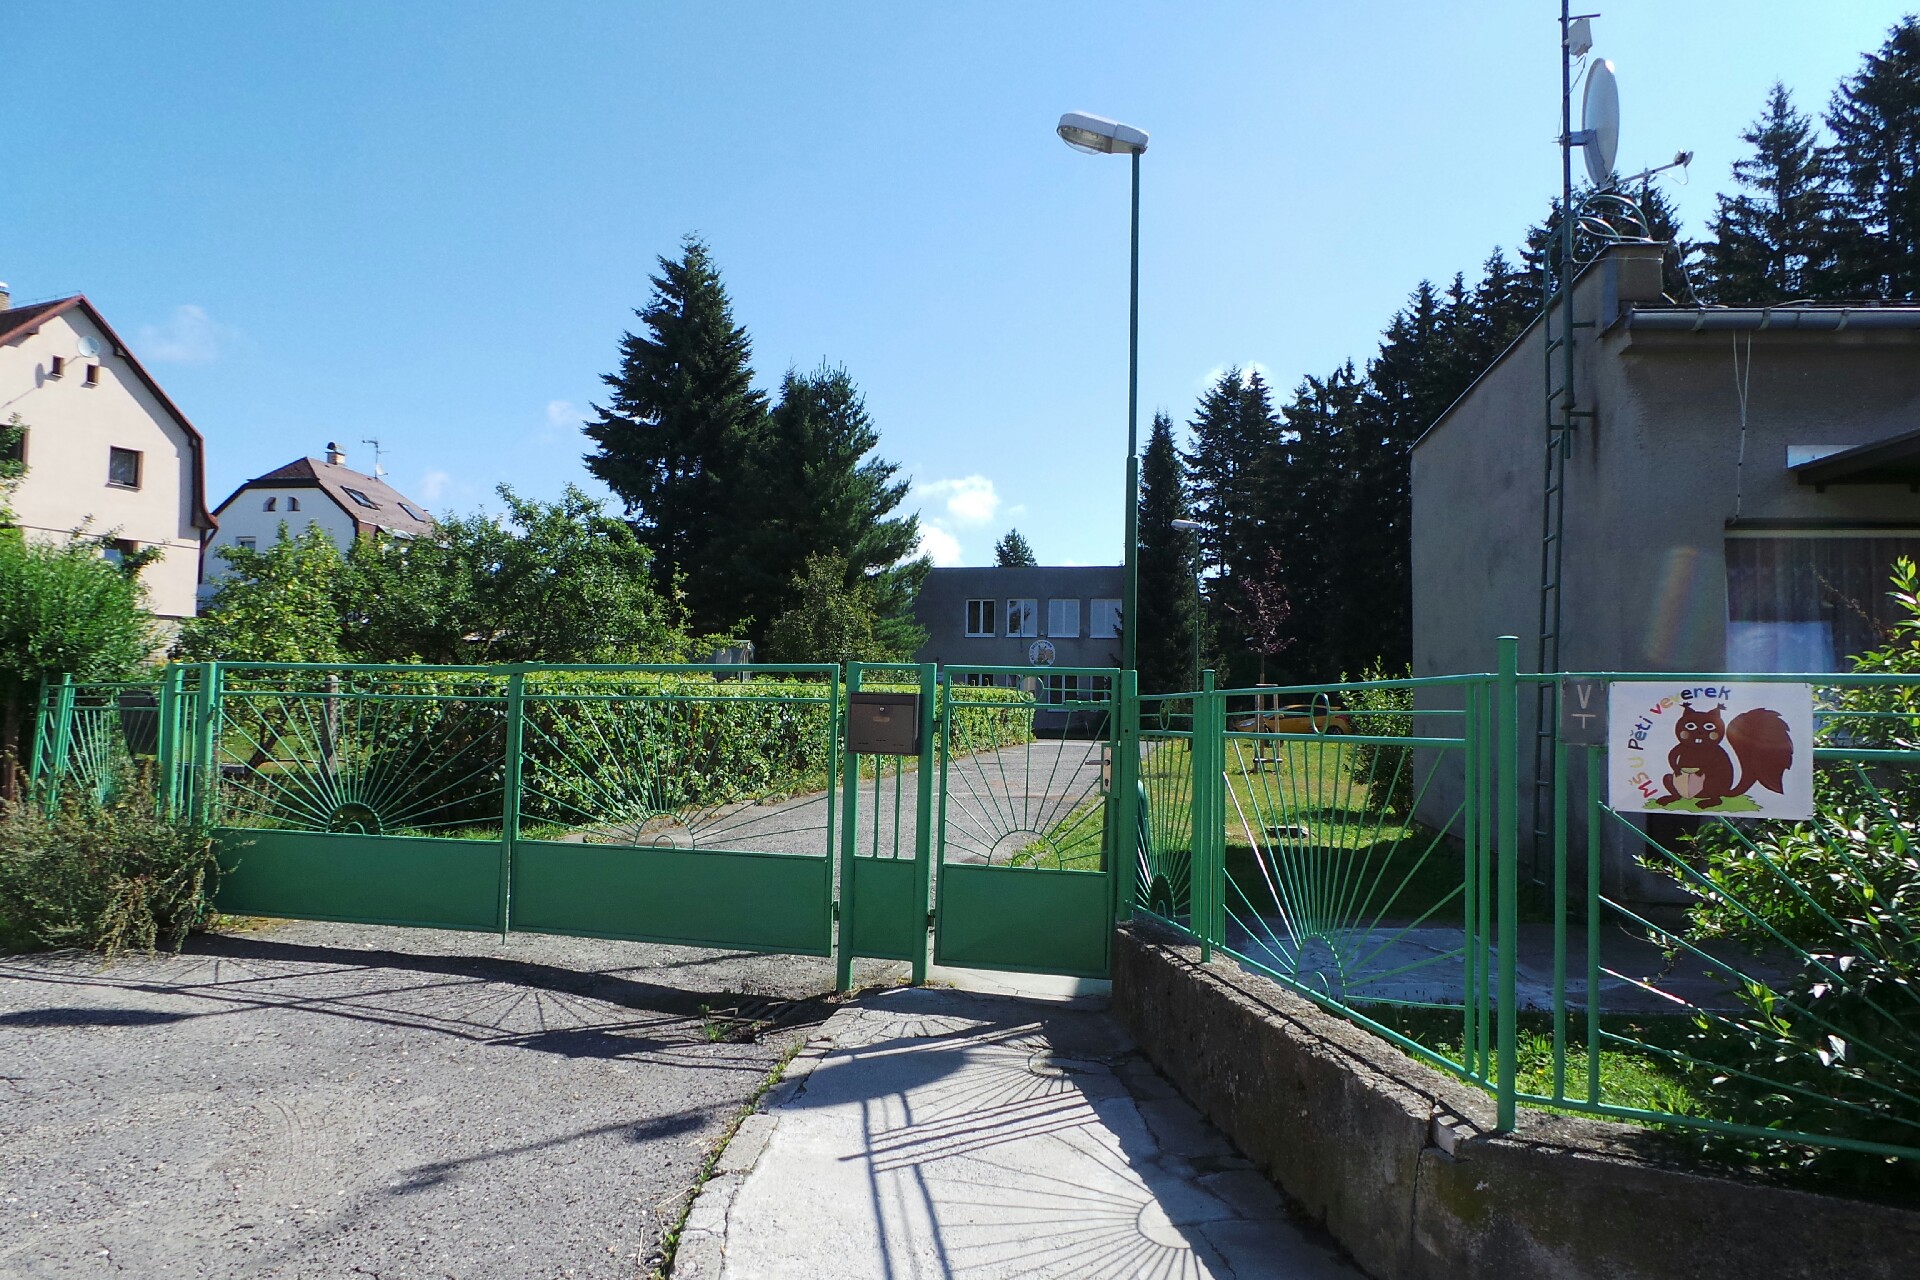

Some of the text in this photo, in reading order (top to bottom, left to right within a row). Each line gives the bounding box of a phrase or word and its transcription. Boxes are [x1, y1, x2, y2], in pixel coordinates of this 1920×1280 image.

[1576, 684, 1592, 709] V
[1649, 685, 1732, 715] veverek
[1627, 715, 1653, 751] Pěti
[1627, 771, 1658, 798] MŠ
